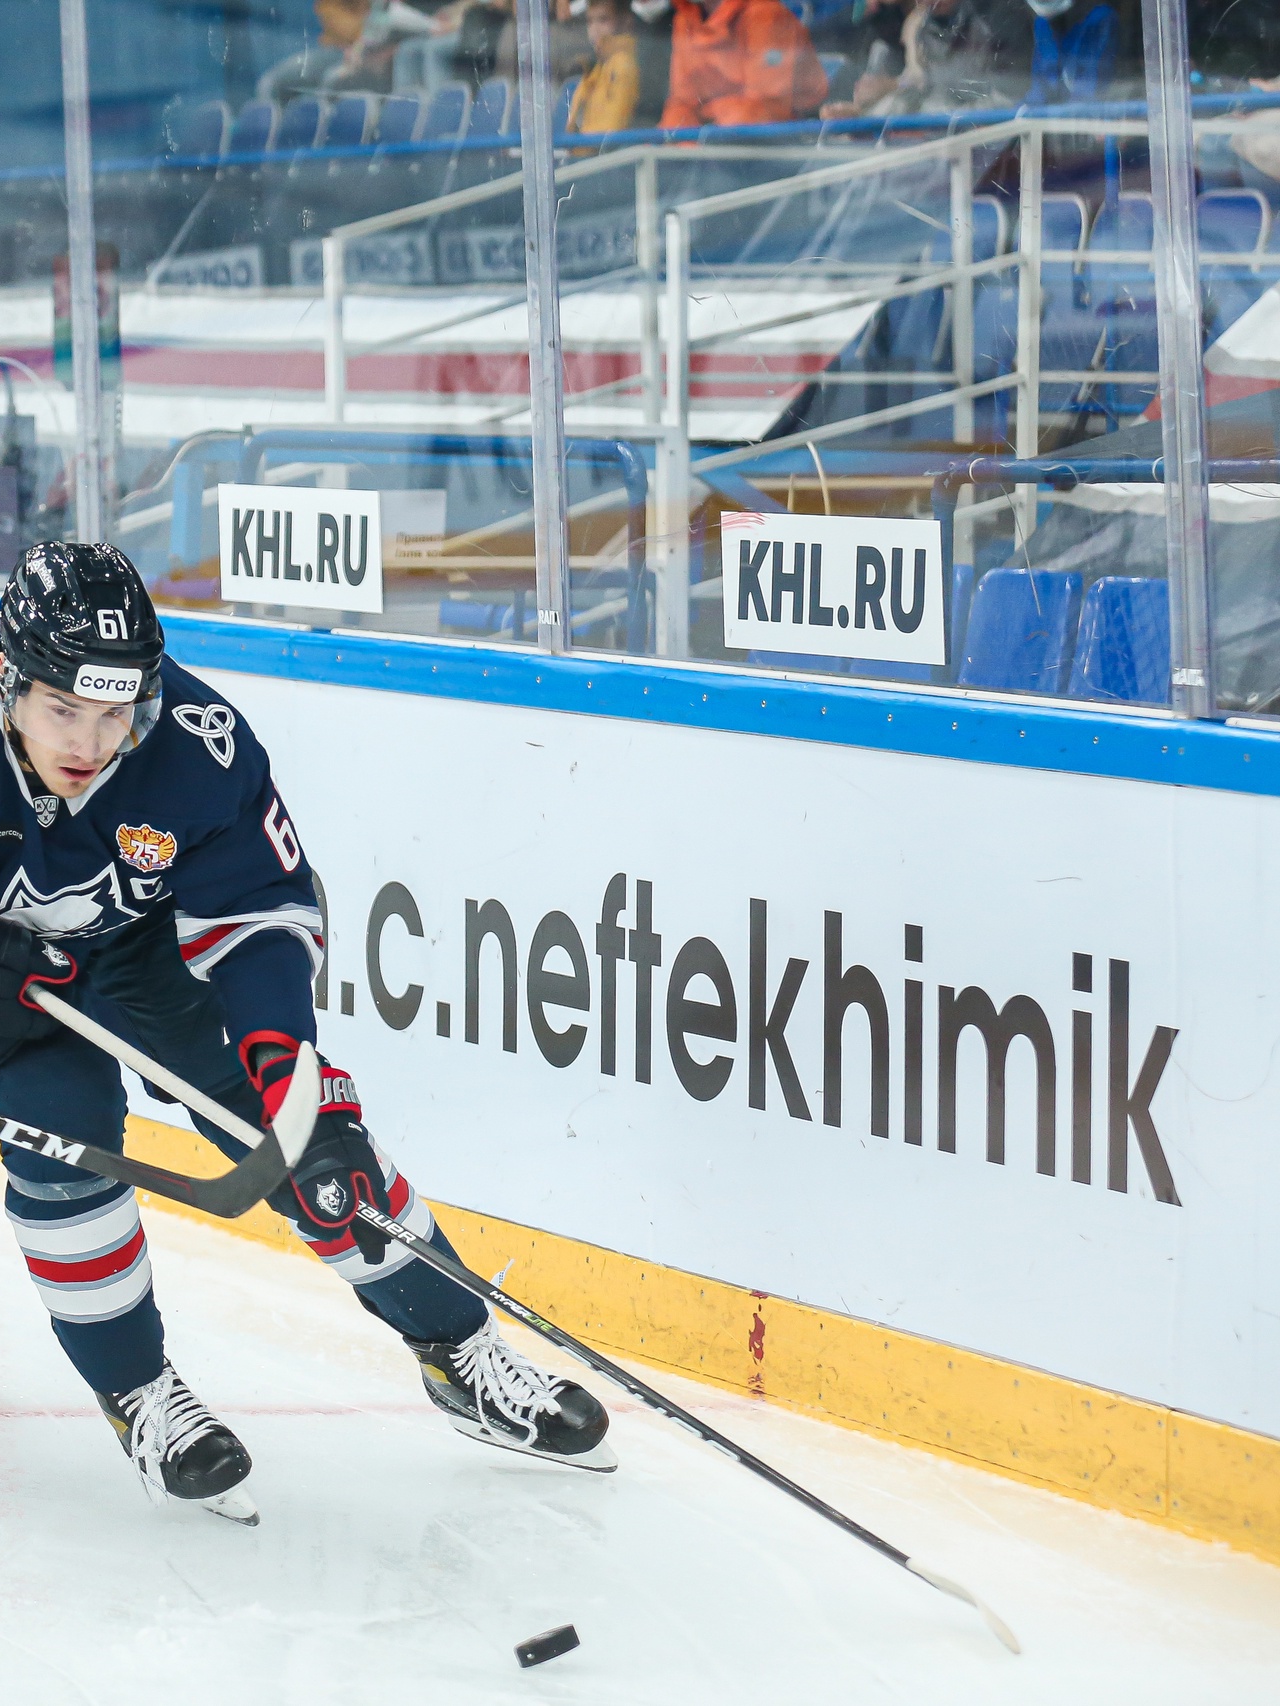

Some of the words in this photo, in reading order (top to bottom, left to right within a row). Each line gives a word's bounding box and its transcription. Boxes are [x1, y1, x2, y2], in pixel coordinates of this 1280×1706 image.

[231, 507, 369, 587] KHL.RU
[738, 539, 927, 634] KHL.RU
[97, 609, 129, 640] 61
[80, 675, 137, 692] согаз
[131, 840, 159, 863] 75
